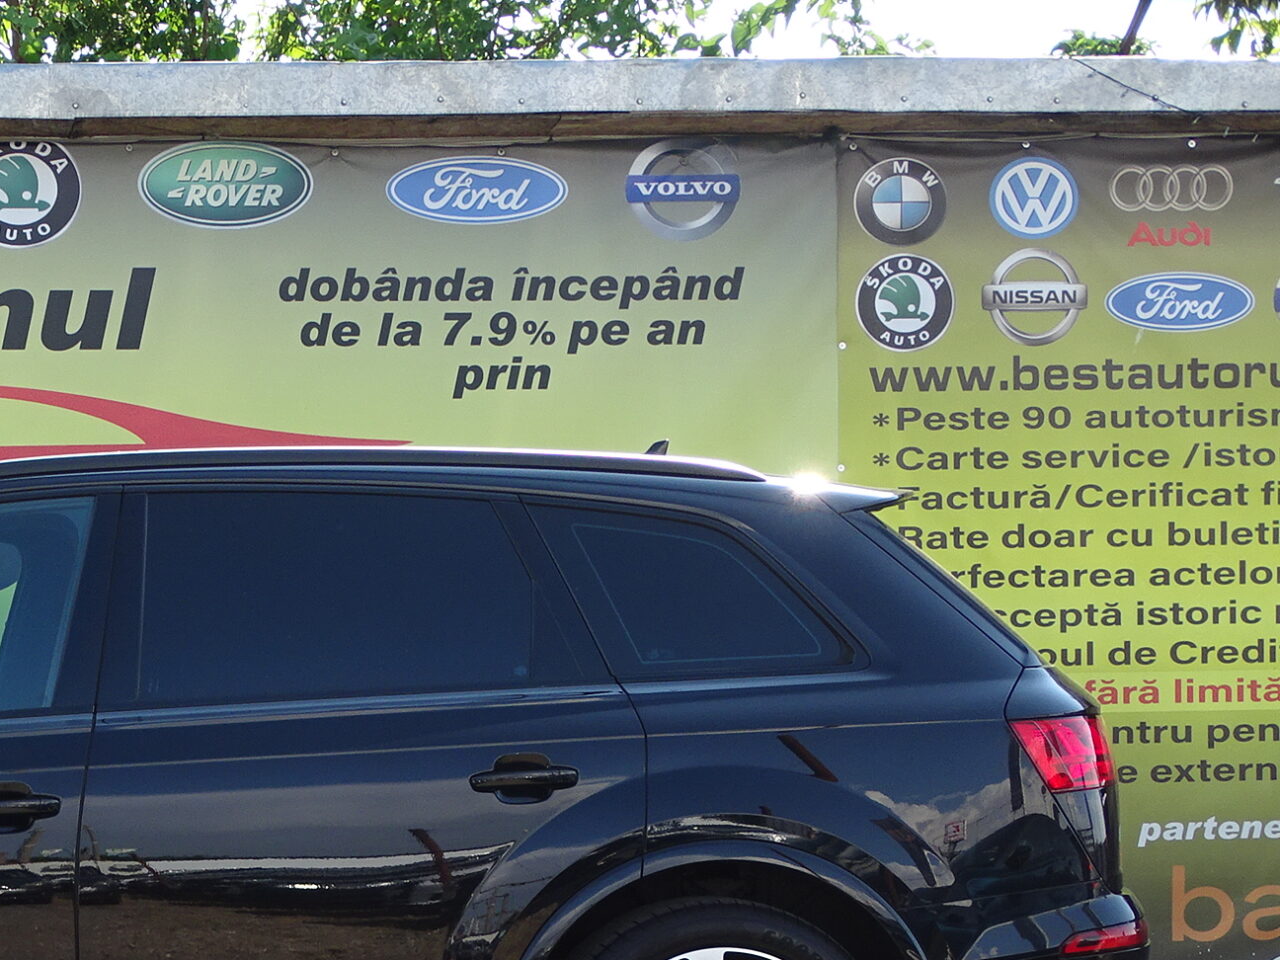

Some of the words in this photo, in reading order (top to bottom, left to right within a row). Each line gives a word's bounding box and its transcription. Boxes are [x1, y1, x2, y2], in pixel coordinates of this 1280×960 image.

[176, 159, 256, 182] LAND
[864, 161, 939, 188] BMW
[184, 184, 284, 207] ROVER
[423, 166, 529, 211] Ford
[634, 181, 732, 196] VOLVO
[1127, 221, 1211, 247] Audi
[278, 267, 494, 302] dobânda
[511, 266, 745, 309] începând
[992, 289, 1078, 306] NISSAN
[1138, 281, 1224, 321] Ford
[300, 313, 361, 347] de
[377, 313, 422, 347] la
[442, 312, 556, 347] 7.9%
[568, 318, 630, 355] pe
[647, 318, 707, 346] an
[880, 330, 930, 347] AUTO
[452, 357, 552, 399] prin
[1023, 406, 1071, 429] 90
[1085, 402, 1280, 429] autoturis
[1021, 443, 1170, 469] service
[1001, 523, 1094, 548] doar
[1106, 528, 1152, 547] cu
[1168, 520, 1280, 547] buleti
[995, 602, 1122, 633] ceptă
[1136, 600, 1262, 626] istoric
[1108, 641, 1157, 665] de
[1150, 760, 1278, 784] extern
